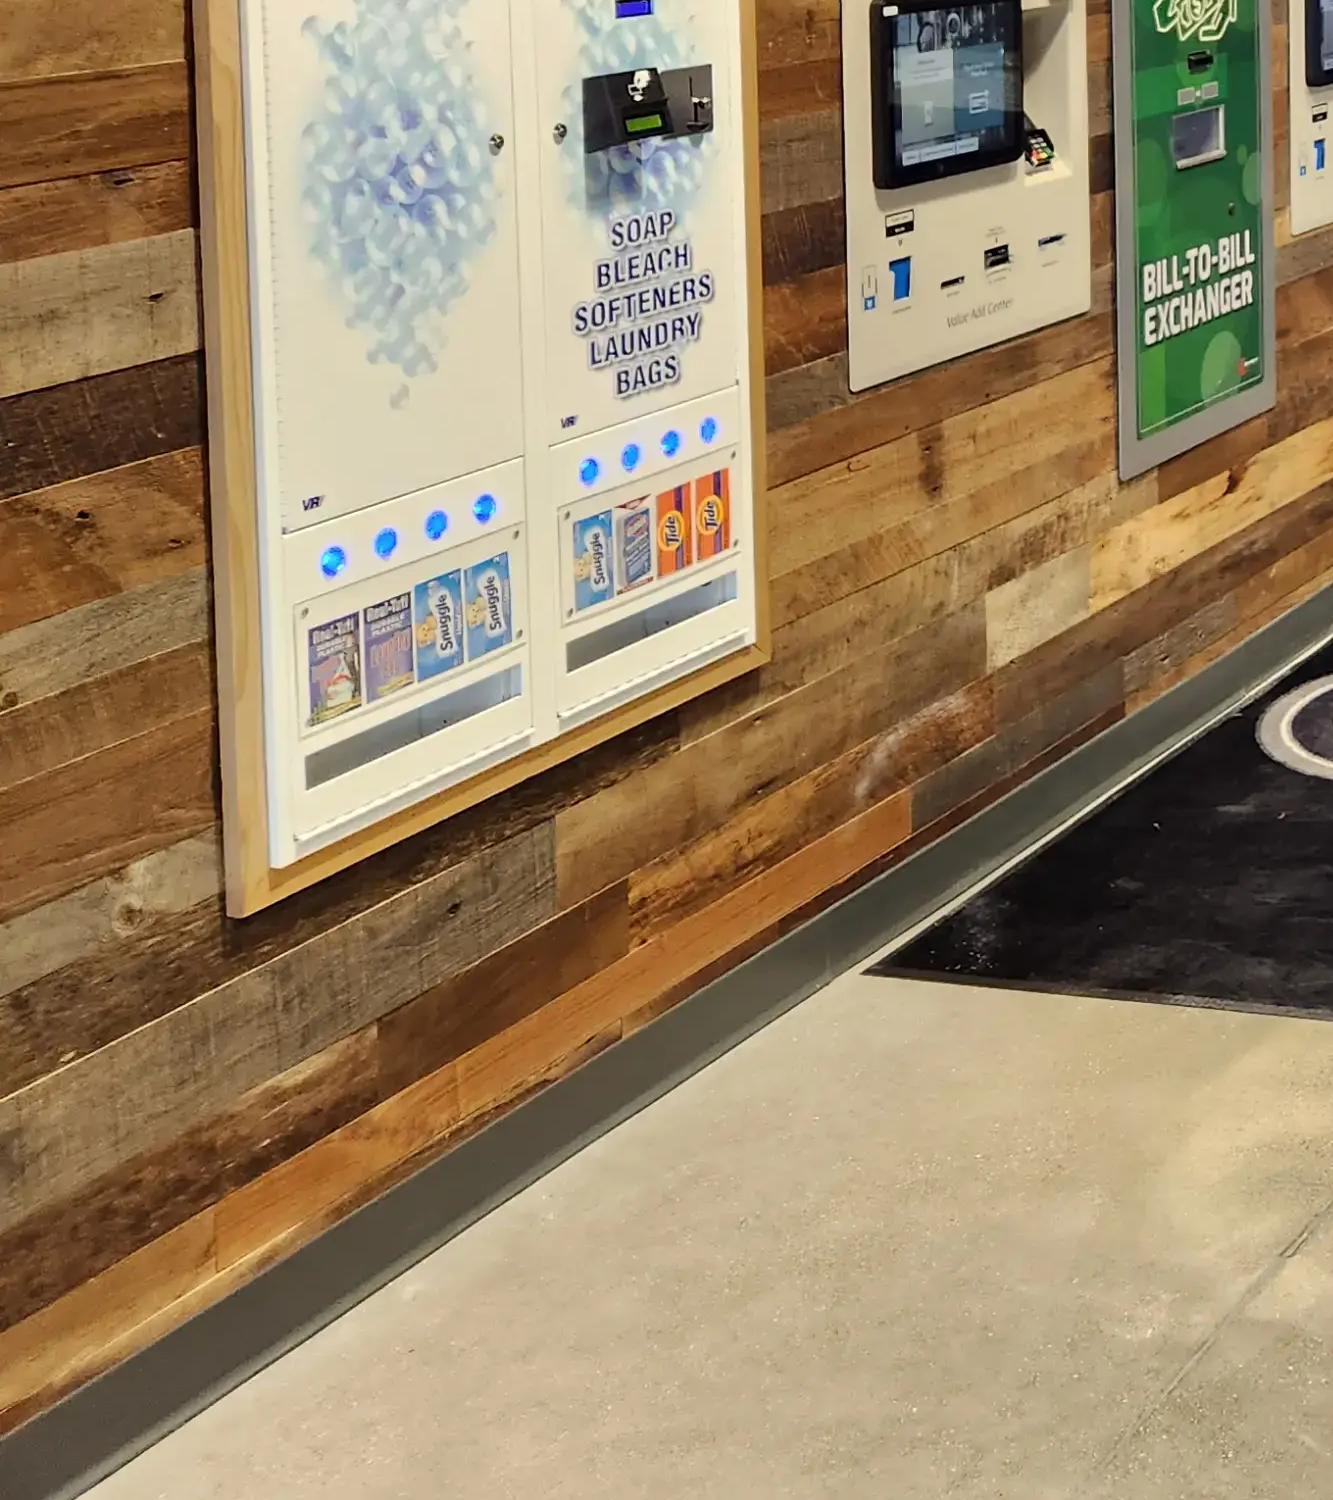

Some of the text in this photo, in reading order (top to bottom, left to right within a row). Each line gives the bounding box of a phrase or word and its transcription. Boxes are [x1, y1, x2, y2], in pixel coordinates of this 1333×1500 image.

[610, 210, 674, 248] SOAP
[596, 244, 691, 288] BLEACH
[1143, 229, 1256, 303] BILL-TO-BILL
[574, 274, 714, 334] SOFTENERS
[1144, 269, 1254, 346] EXCHANGER
[589, 314, 700, 367] LAUNDRY
[615, 356, 681, 397] BAGS
[665, 515, 681, 547] Tide
[704, 499, 719, 531] Tide
[592, 531, 606, 586] Snuggle
[437, 593, 454, 652] Snuggle
[485, 575, 503, 631] Snuggle
